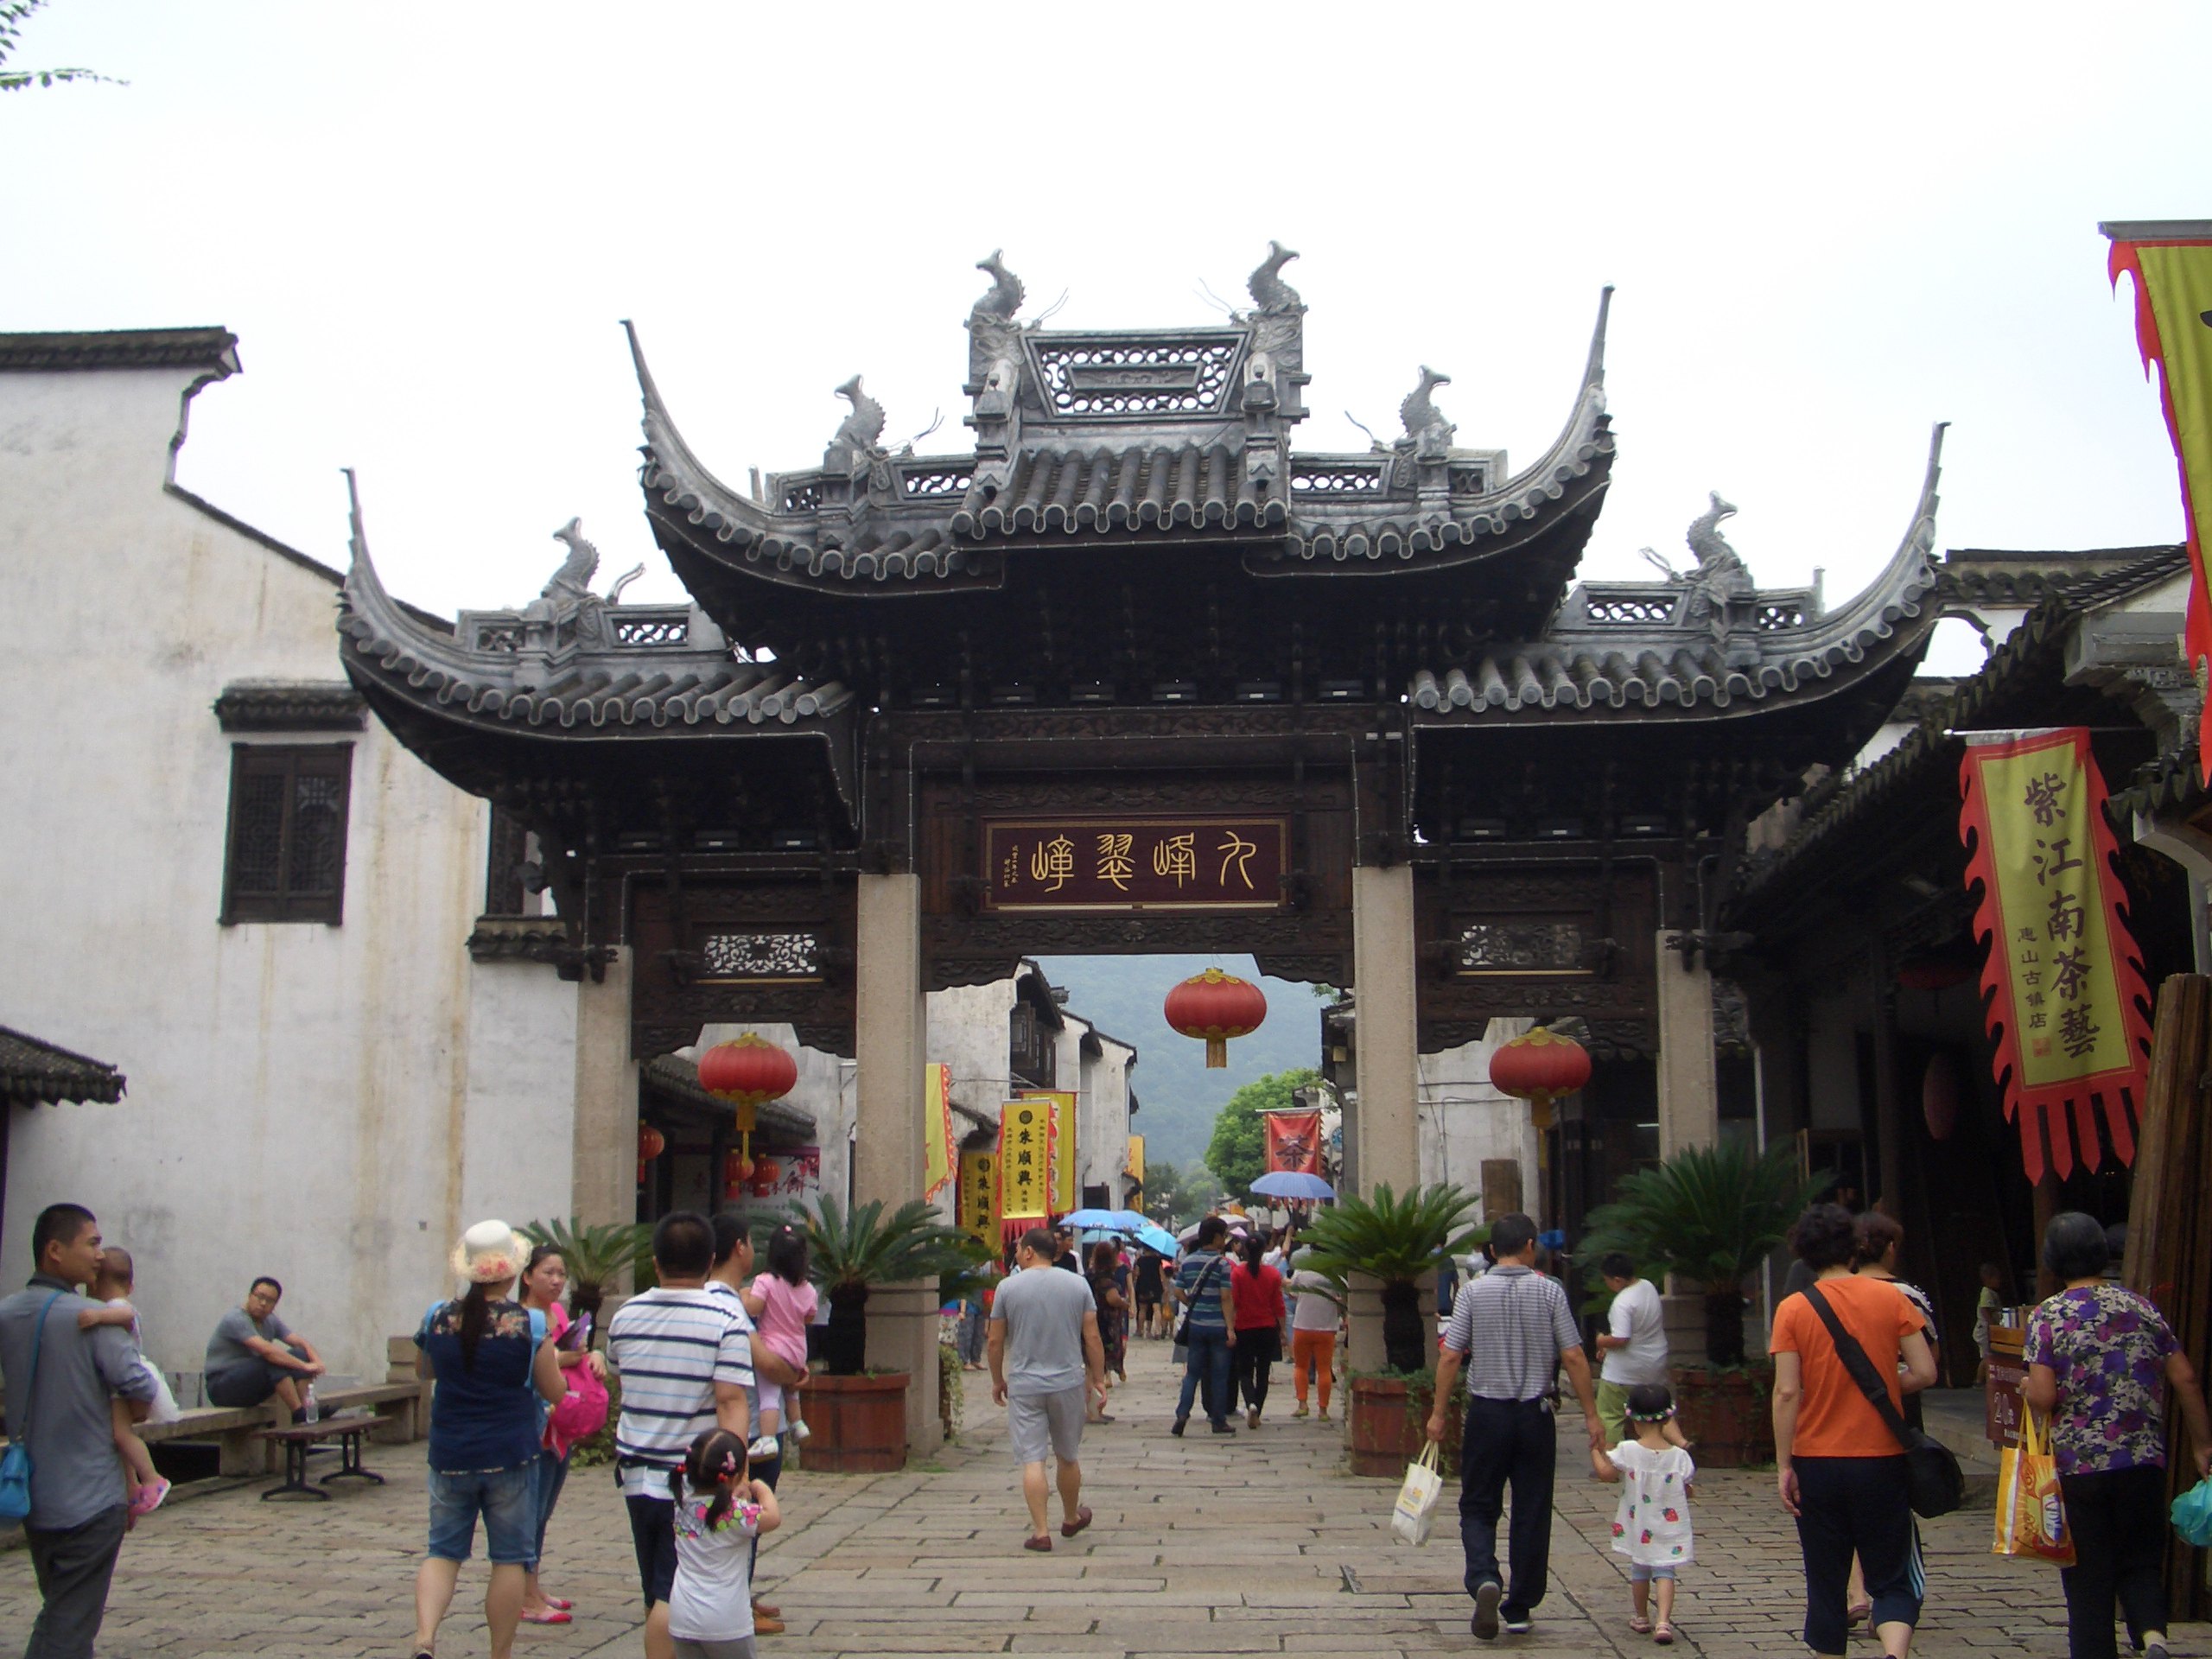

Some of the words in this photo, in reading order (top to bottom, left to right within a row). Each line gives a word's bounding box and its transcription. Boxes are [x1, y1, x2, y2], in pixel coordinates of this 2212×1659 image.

[2023, 772, 2101, 1059] 紫江南茶藝
